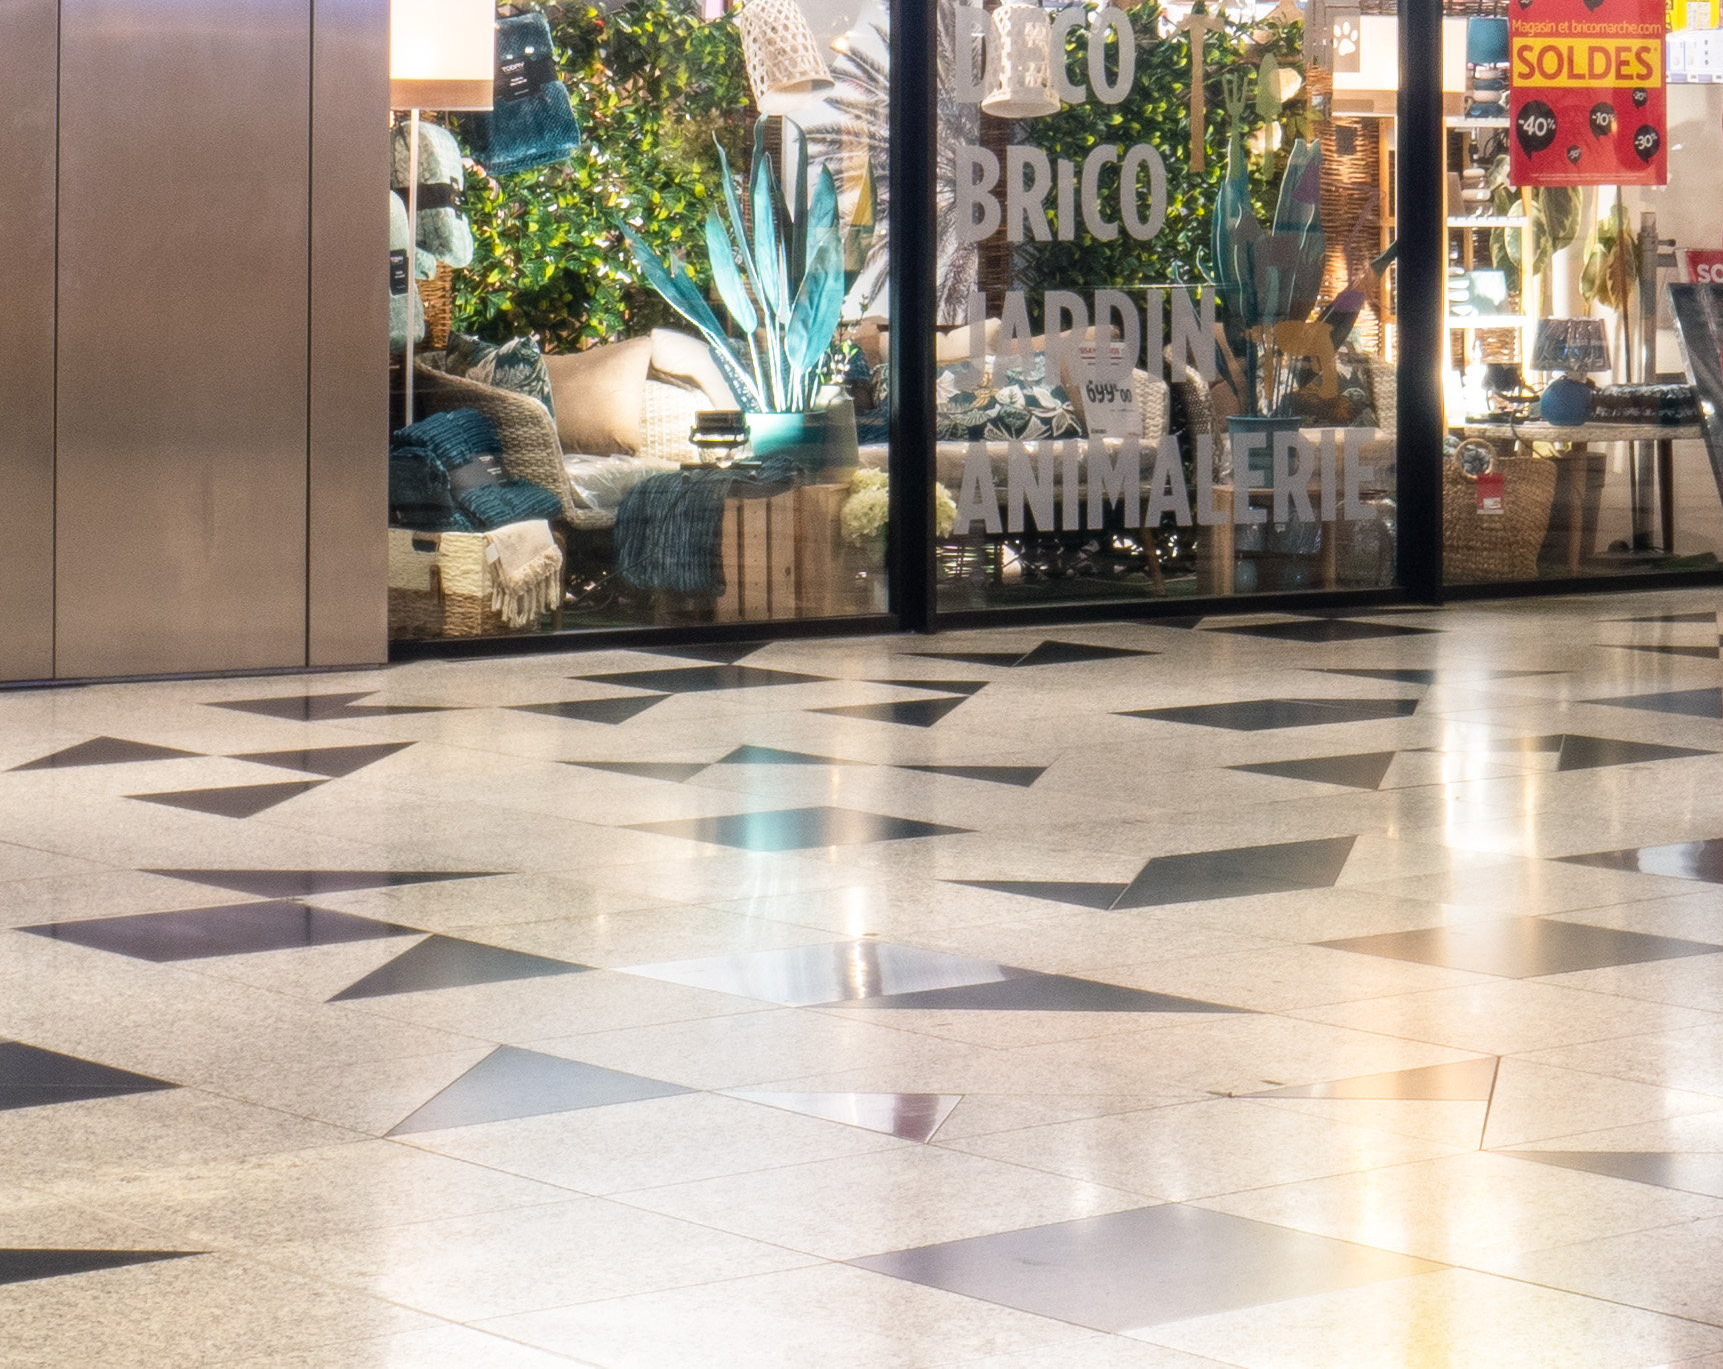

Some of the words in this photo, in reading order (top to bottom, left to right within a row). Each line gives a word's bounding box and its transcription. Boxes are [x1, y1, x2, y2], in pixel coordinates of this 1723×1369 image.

[1512, 19, 1555, 36] Magasin
[1558, 20, 1570, 32] et
[1572, 20, 1661, 34] bricomarche.com
[1518, 114, 1557, 137] -40%
[1591, 112, 1615, 126] -10%
[1634, 133, 1658, 150] -30%
[955, 287, 1216, 387] JARDIN
[953, 429, 1378, 535] ANIMALERIE
